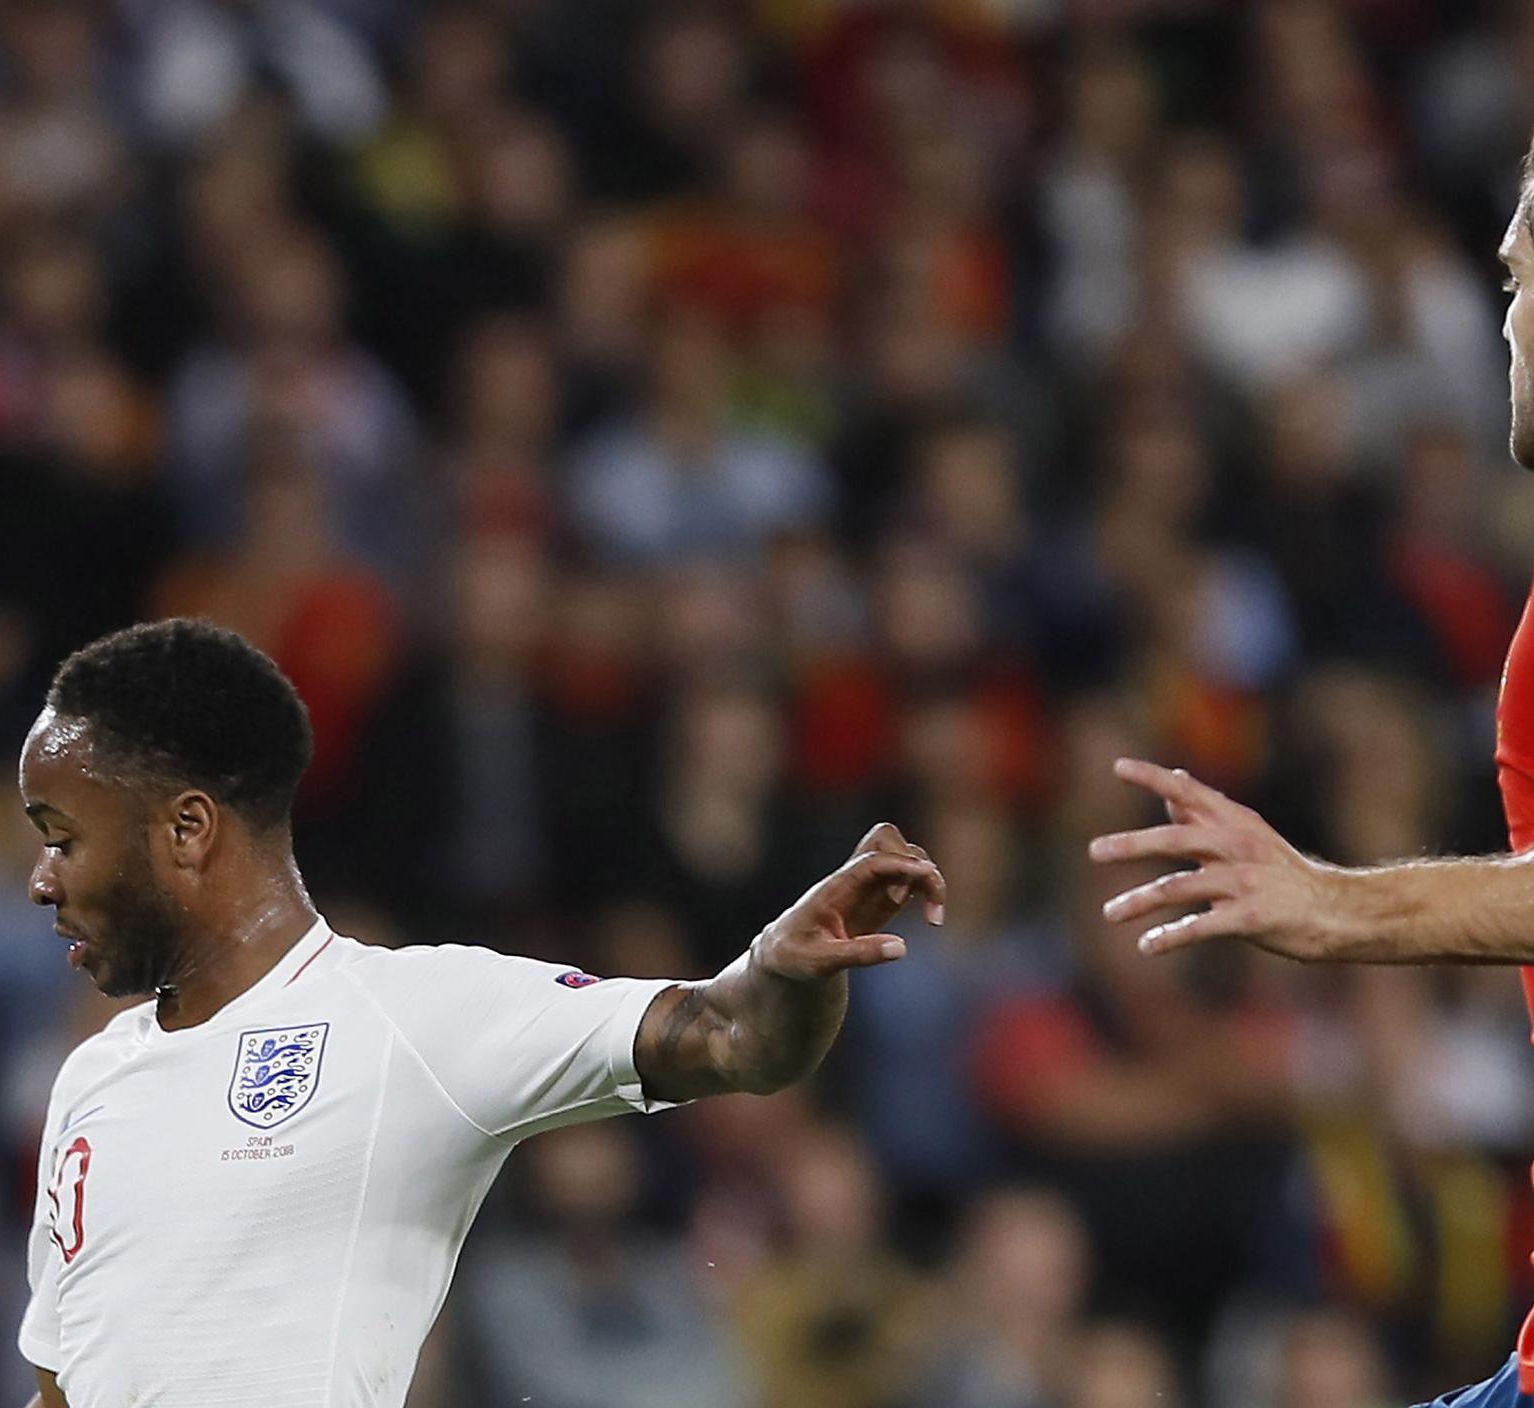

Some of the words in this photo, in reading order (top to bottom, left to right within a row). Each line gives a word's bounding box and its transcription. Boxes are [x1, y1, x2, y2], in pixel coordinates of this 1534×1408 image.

[246, 1135, 273, 1147] SPAIN
[231, 1147, 271, 1160] OCTOBER
[273, 1144, 295, 1158] 2018
